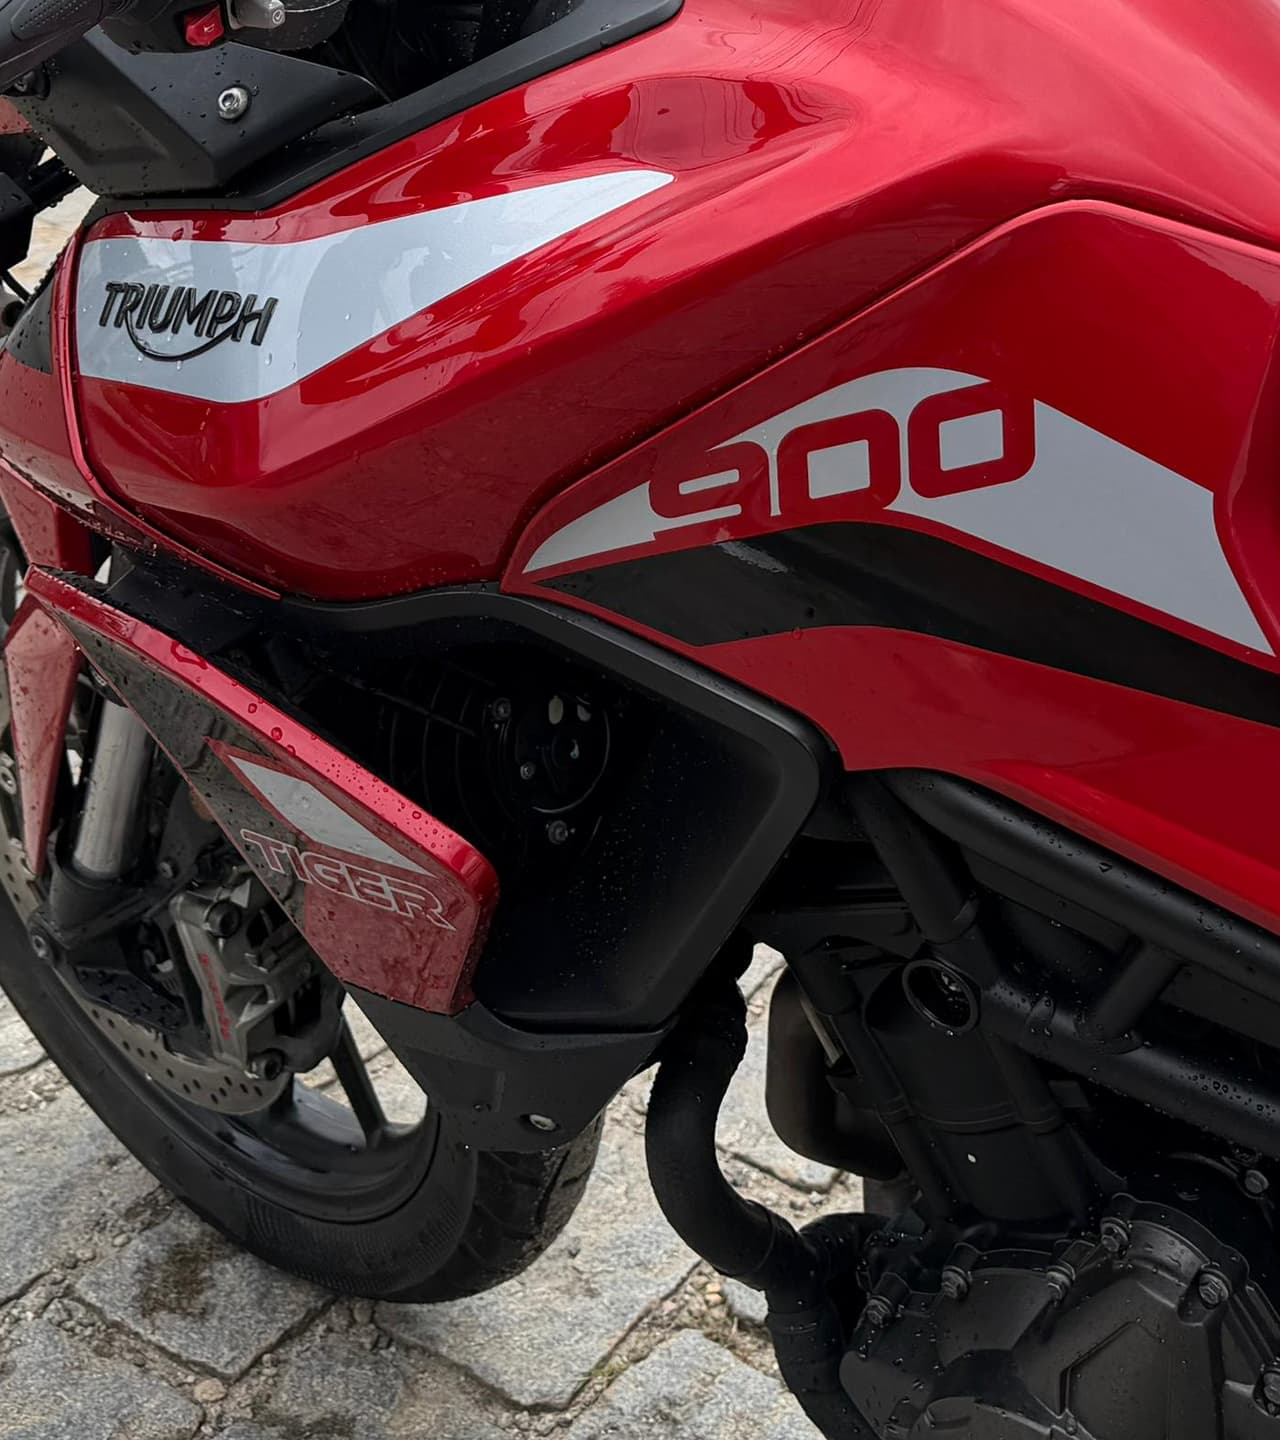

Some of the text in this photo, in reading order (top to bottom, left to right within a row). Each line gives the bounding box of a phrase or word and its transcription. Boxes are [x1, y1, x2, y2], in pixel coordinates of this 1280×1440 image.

[99, 280, 278, 362] TRIUMPH
[648, 382, 1036, 539] 900
[240, 828, 457, 932] TIGER
